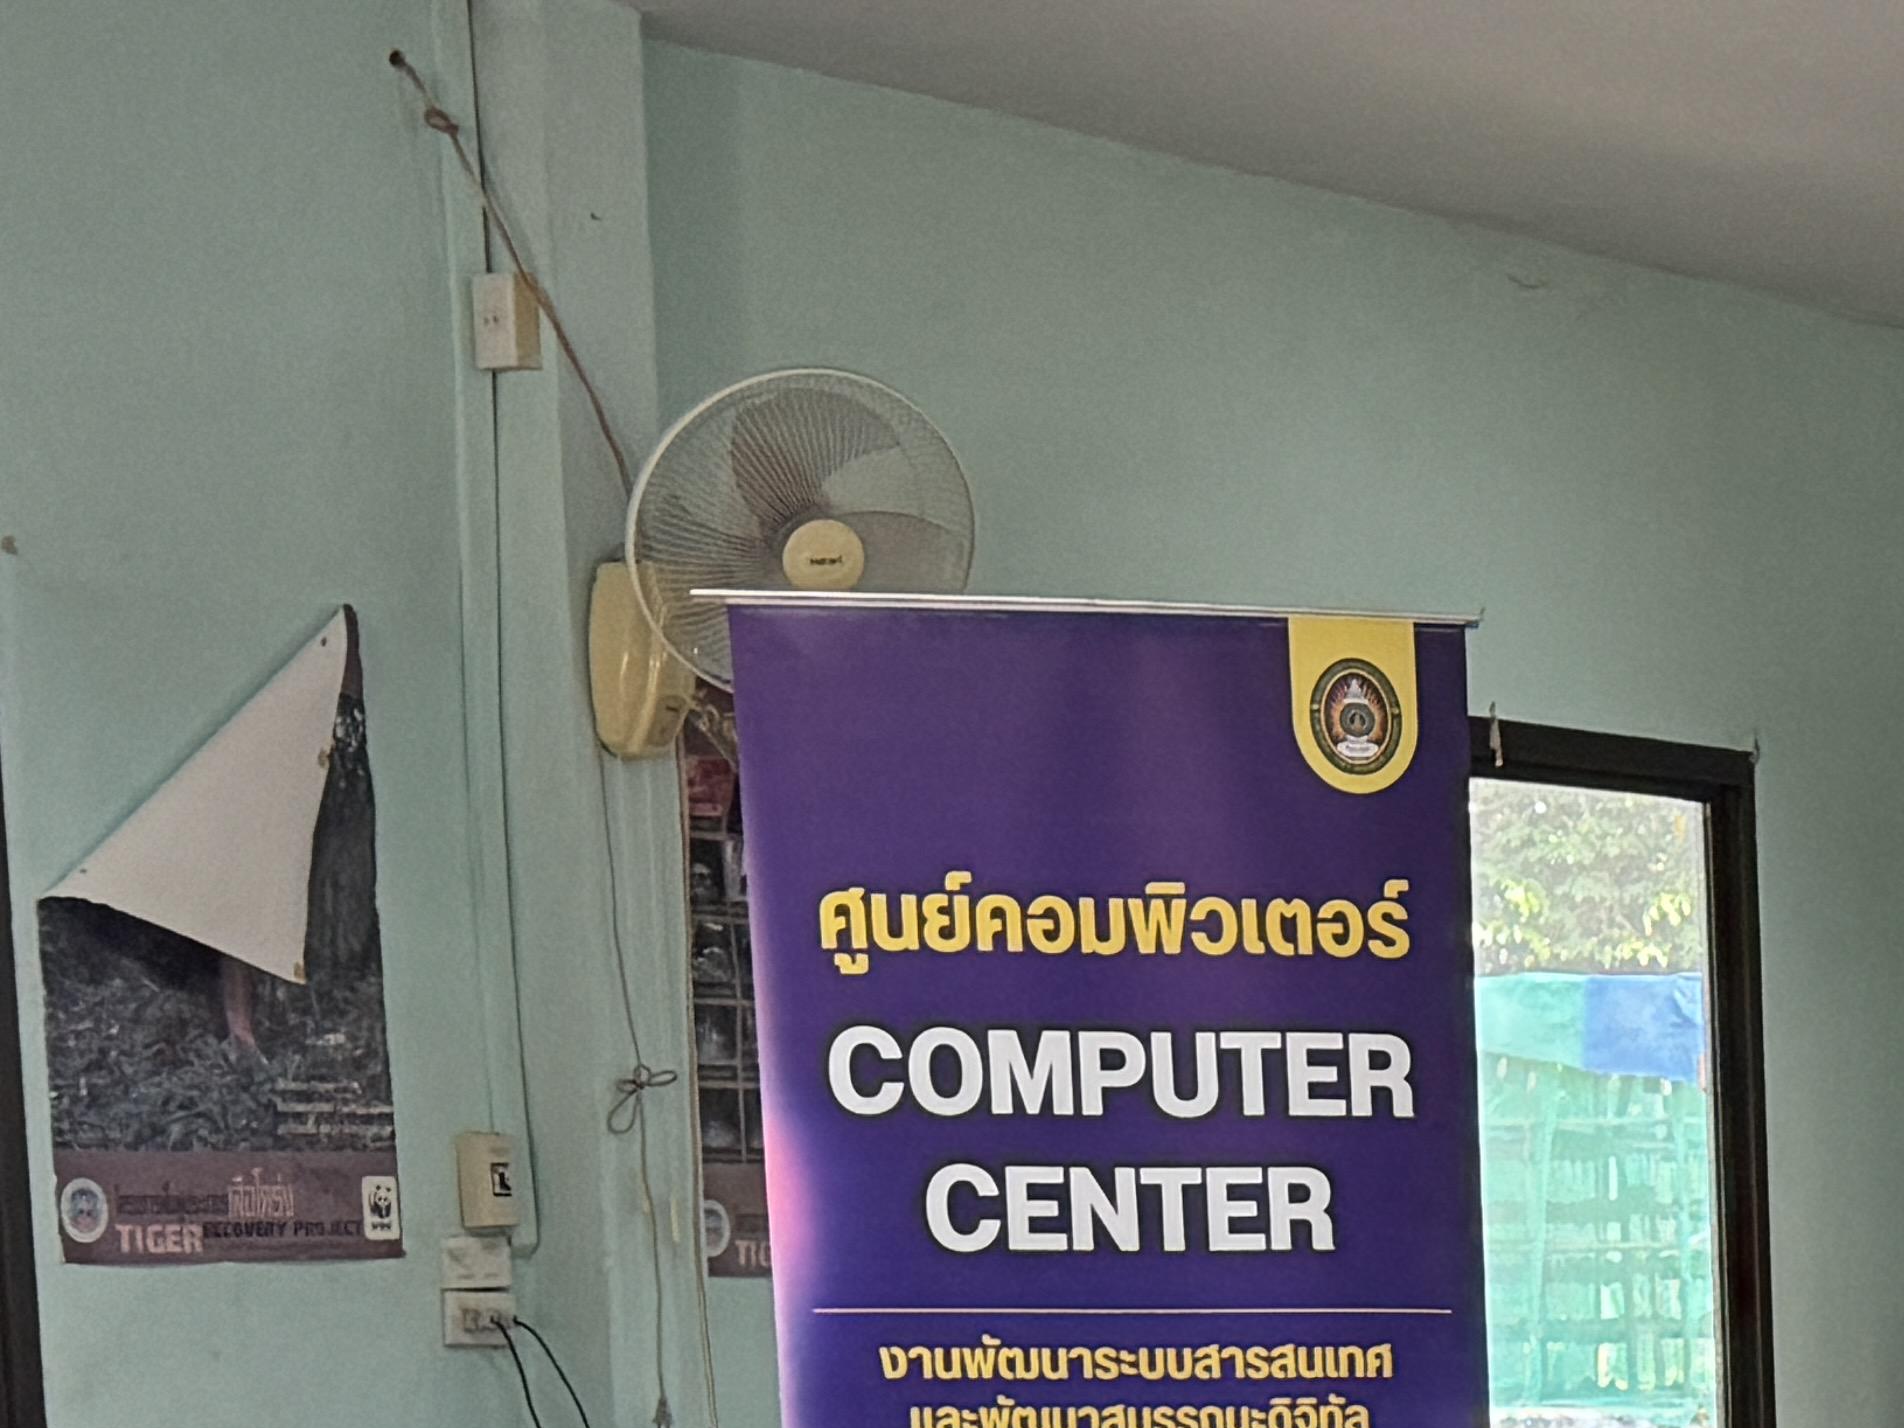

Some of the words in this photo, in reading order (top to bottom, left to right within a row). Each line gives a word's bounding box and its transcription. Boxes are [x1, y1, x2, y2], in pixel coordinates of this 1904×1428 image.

[819, 871, 1411, 975] ศูนย์คอมพิวเตอร์
[828, 1025, 1415, 1118] COMPUTER
[115, 1223, 203, 1254] TIGER
[926, 1164, 1335, 1253] CENTER
[880, 1335, 1393, 1382] งานพัฒนาระบบสารสนเทศ
